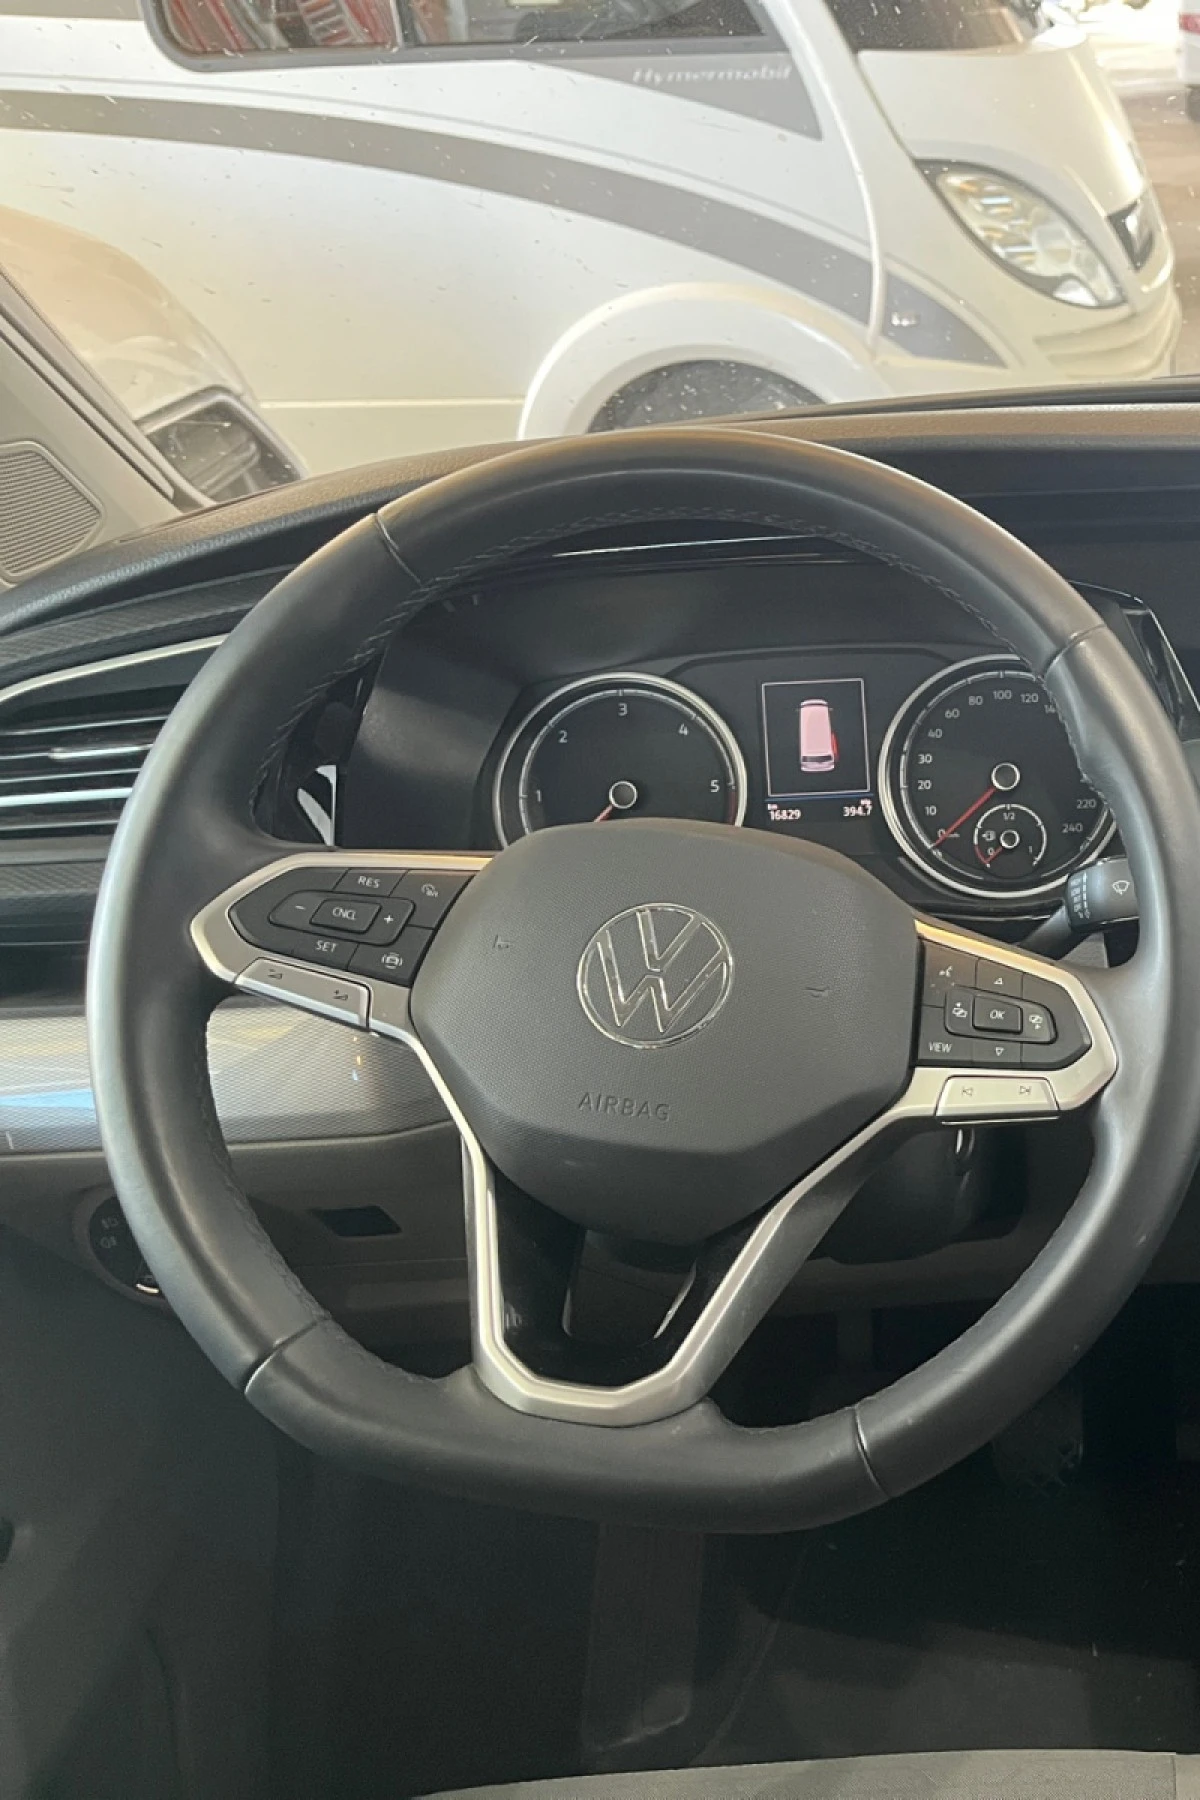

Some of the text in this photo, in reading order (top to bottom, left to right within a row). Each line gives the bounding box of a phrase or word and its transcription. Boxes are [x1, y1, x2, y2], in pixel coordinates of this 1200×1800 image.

[992, 689, 1012, 700] 100
[1020, 693, 1039, 703] 120
[968, 696, 983, 706] 80
[617, 703, 628, 717] 3
[944, 708, 960, 719] 60
[678, 723, 689, 736] 4
[927, 728, 943, 739] 40
[558, 730, 568, 744] 2
[917, 753, 933, 765] 30
[710, 780, 720, 792] 5
[917, 779, 932, 790] 20
[1076, 799, 1097, 810] 220
[924, 805, 937, 816] 10
[1003, 812, 1015, 821] 1/2
[1062, 823, 1083, 834] 240
[357, 875, 380, 889] RES
[332, 907, 356, 921] CNCL
[315, 940, 338, 953] SET
[990, 1010, 1005, 1020] OK
[929, 1042, 952, 1053] VIEW
[578, 1091, 670, 1121] AIRBAG
